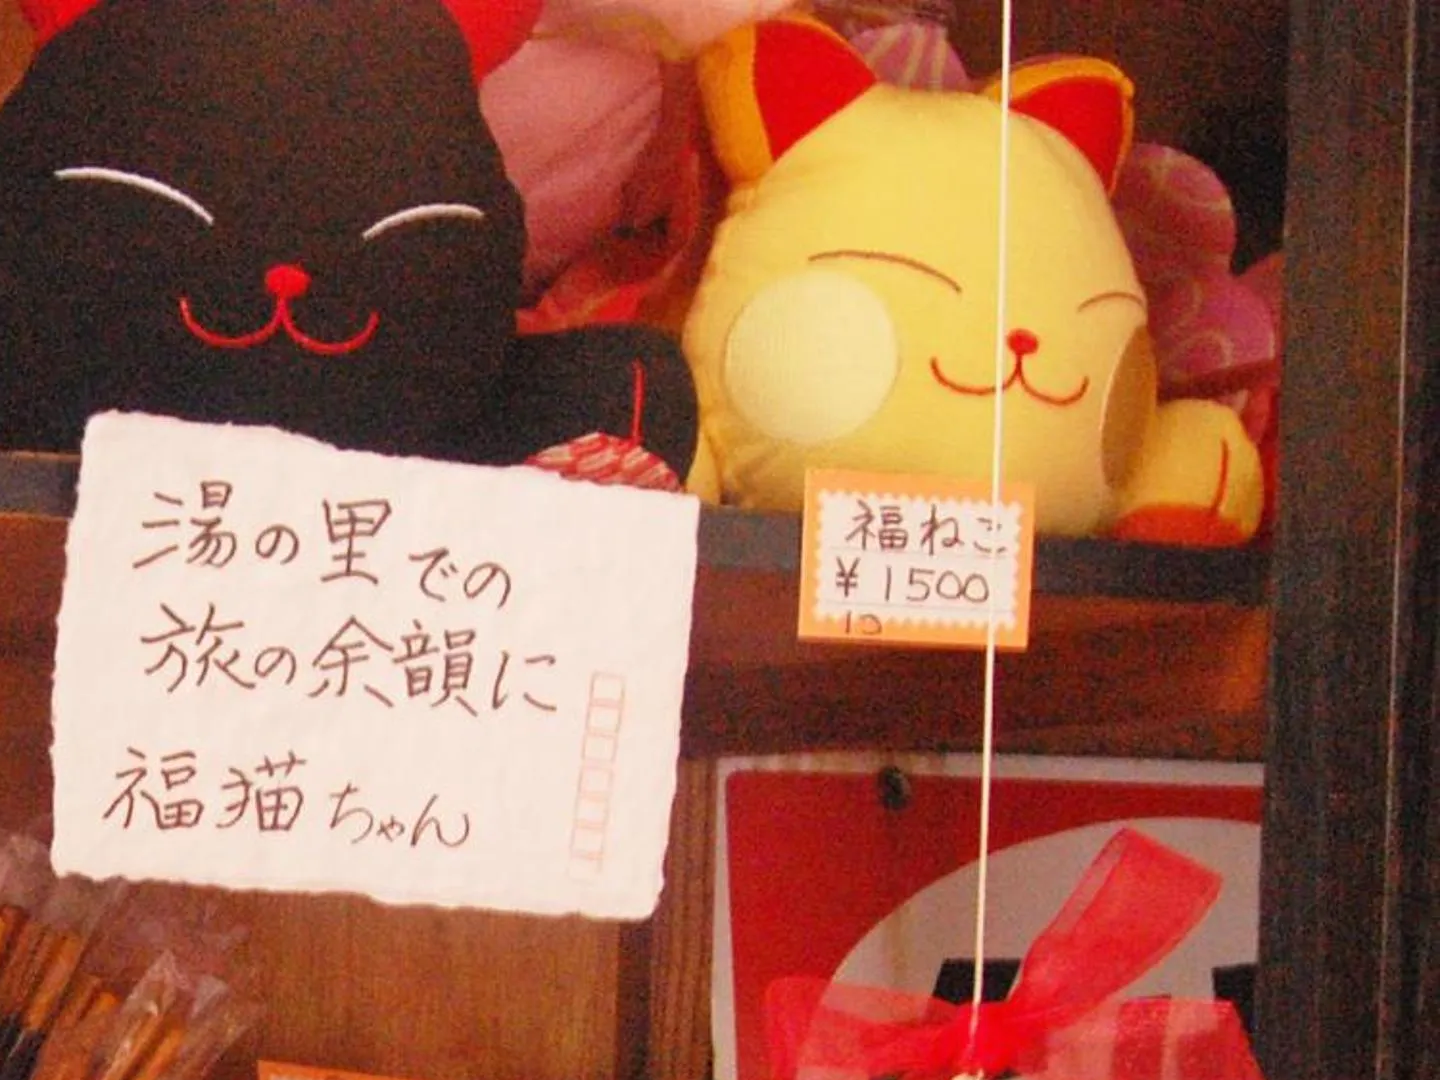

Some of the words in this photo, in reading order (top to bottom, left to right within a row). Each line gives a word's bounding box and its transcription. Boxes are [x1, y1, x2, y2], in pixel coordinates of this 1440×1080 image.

[133, 480, 512, 609] 湯の里での
[140, 603, 558, 717] 旅の余韻に
[103, 747, 471, 848] 福猫ちゃん
